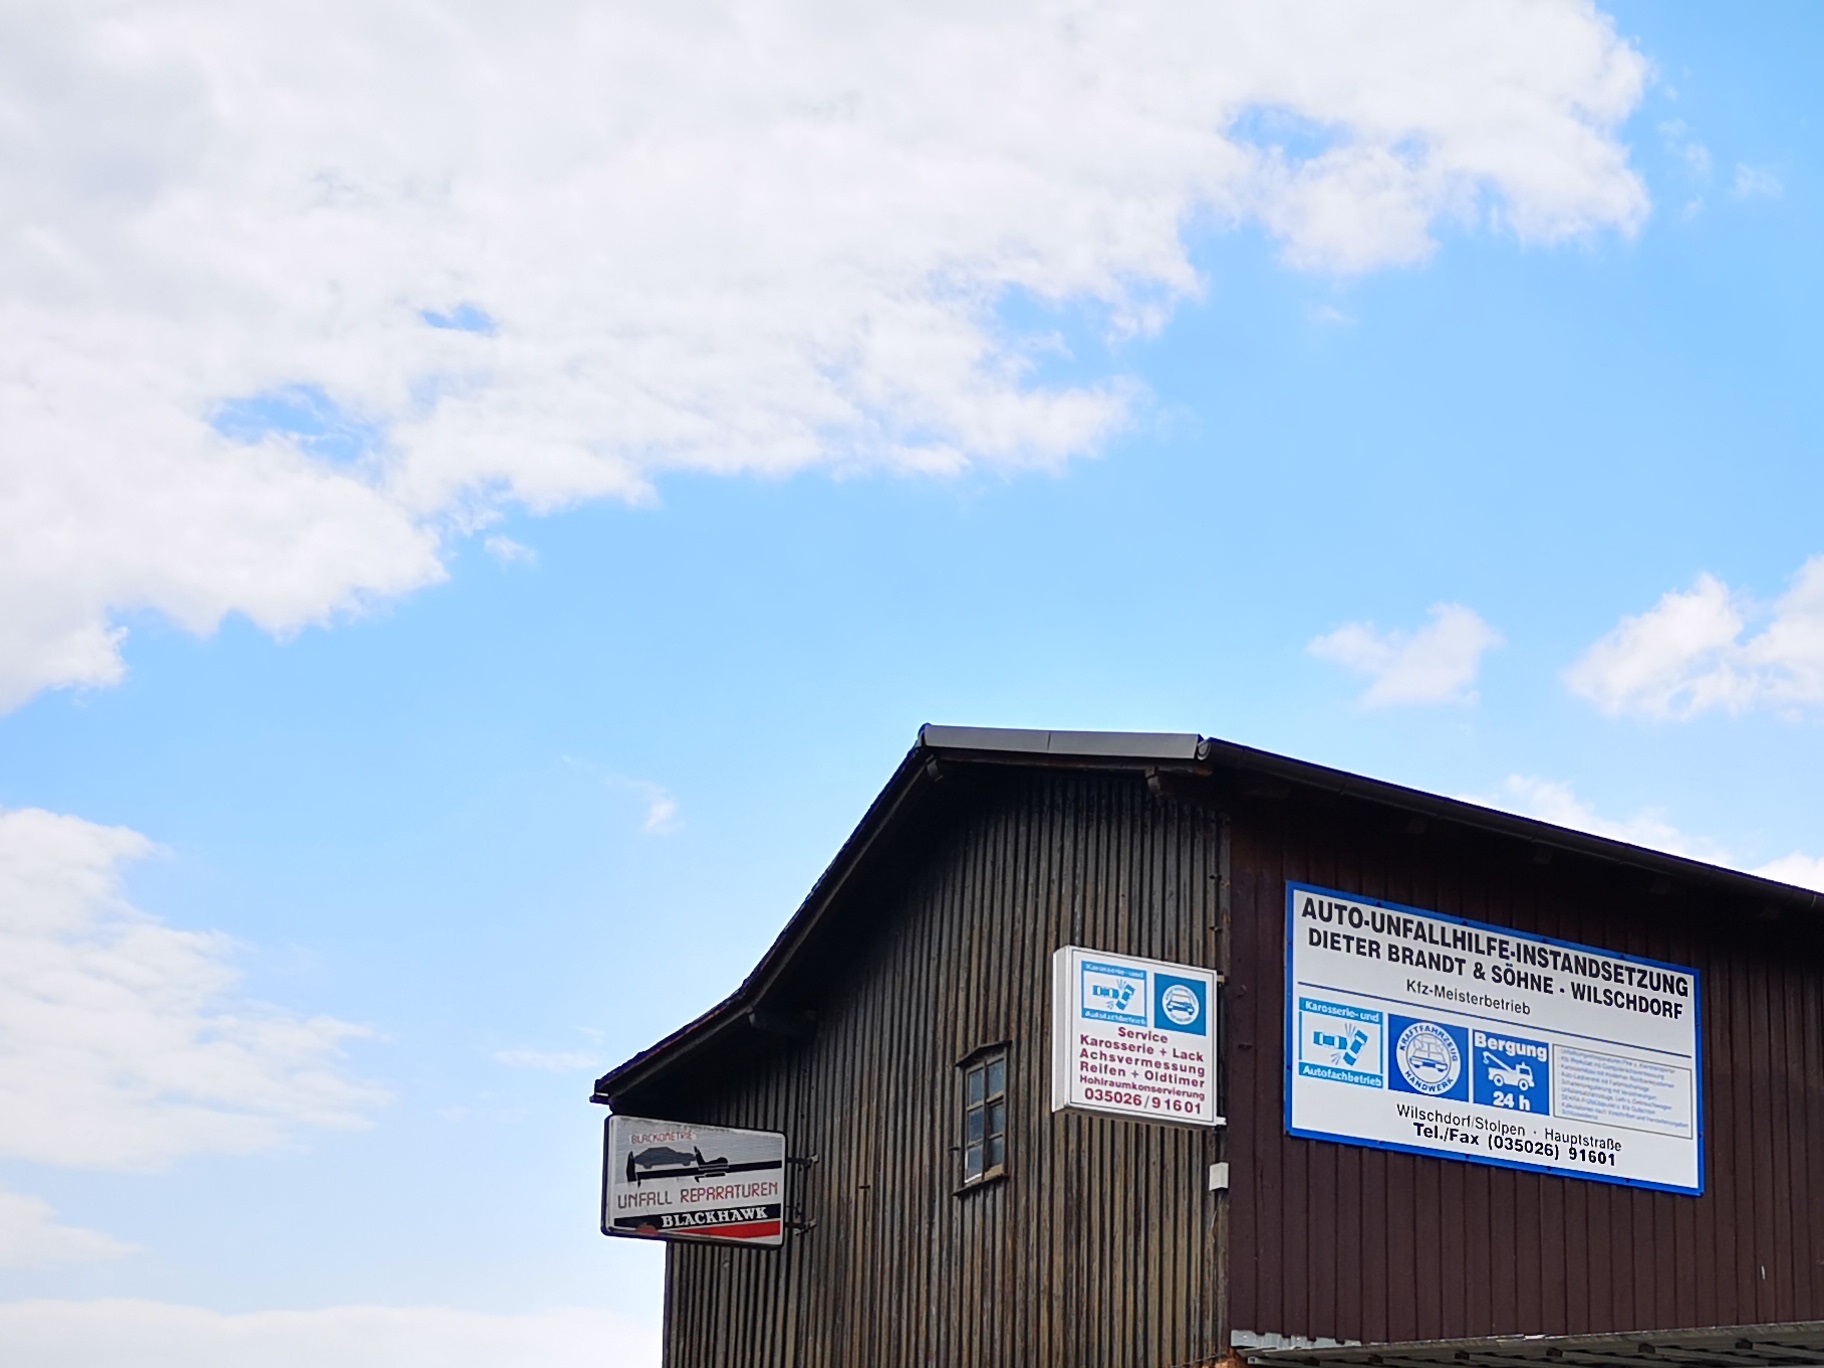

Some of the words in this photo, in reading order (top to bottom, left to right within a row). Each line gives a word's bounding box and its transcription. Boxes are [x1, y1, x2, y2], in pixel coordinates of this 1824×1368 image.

[1301, 896, 1689, 998] AUTO-UNFALLHILFE-INSTANDSETZUNG
[1308, 927, 1381, 959] DIETER
[1387, 943, 1467, 976] BRANDT
[1473, 961, 1487, 981] &
[1491, 963, 1554, 995] SÖHNE
[1570, 981, 1683, 1020] WILSCHDORF
[1406, 978, 1531, 1015] Kfz-Meisterbetrieb
[1360, 1012, 1380, 1022] und
[1079, 1033, 1155, 1056] Karosserie
[1172, 1048, 1205, 1063] Lack
[1118, 1026, 1169, 1044] Service
[1399, 1024, 1459, 1062] KRAFTFAHRZEUG
[1474, 1031, 1548, 1062] Bergung
[1079, 1048, 1206, 1078] Achsvermessung
[1079, 1060, 1126, 1077] Reifen
[1144, 1070, 1206, 1089] Oldtimer
[1303, 1065, 1382, 1087] Autofachbetrieb
[1079, 1074, 1206, 1102] Hohlraumkonservierung
[1404, 1069, 1454, 1093] HANDWERK
[1492, 1090, 1515, 1108] 24
[1519, 1094, 1531, 1111] h
[1396, 1103, 1526, 1137] Wilschdorf/Stolpen
[1544, 1127, 1622, 1152] Hauptstraße
[1413, 1121, 1480, 1147] Tel./Fax
[1487, 1133, 1560, 1161] (035026)
[1568, 1147, 1616, 1167] 91601
[617, 1190, 674, 1210] UNFALL
[680, 1181, 779, 1204] REPARATUREN
[660, 1205, 769, 1228] BLACKHAWK
